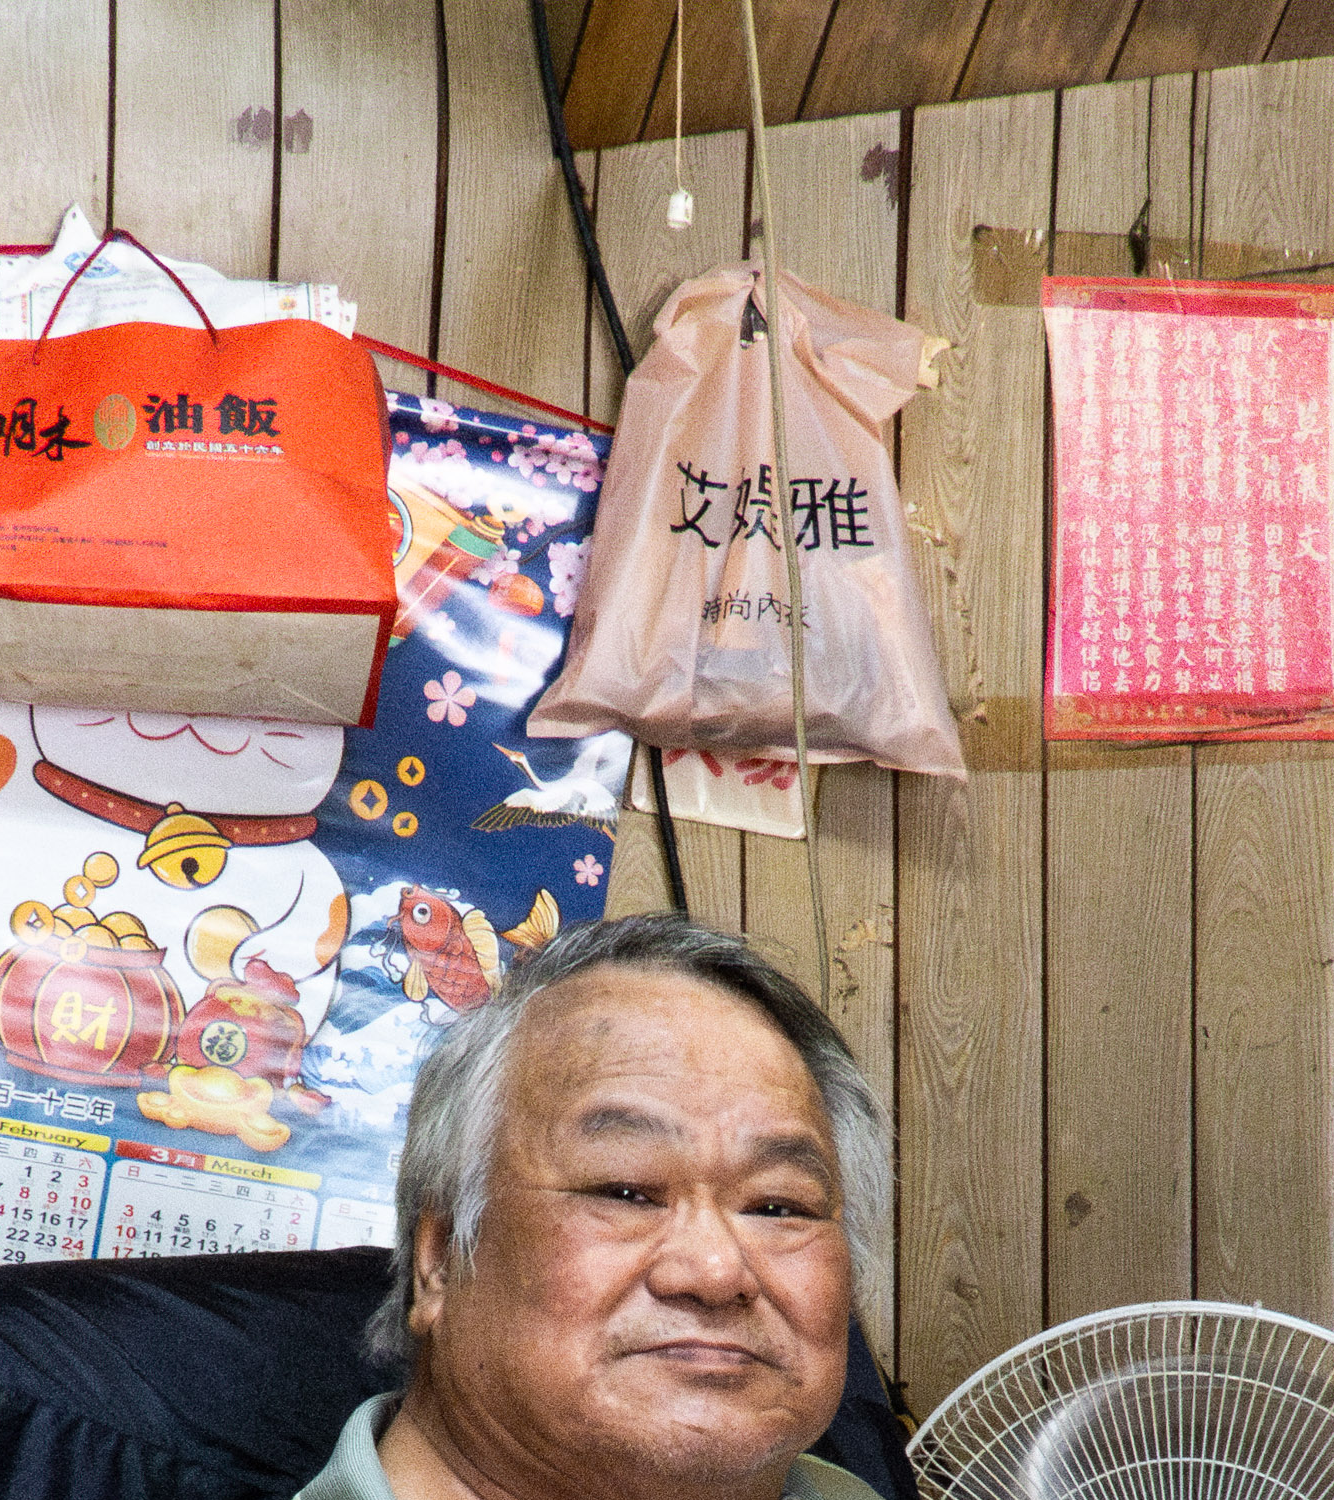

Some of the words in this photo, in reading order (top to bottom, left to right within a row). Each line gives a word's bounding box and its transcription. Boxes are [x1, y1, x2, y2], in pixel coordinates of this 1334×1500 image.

[143, 393, 281, 437] 油飯
[50, 992, 119, 1051] 財
[205, 1026, 239, 1062] 福
[0, 1121, 87, 1148] February
[150, 1148, 195, 1167] 3月
[211, 1159, 273, 1180] March
[25, 1166, 32, 1177] 1
[51, 1171, 62, 1182] 2
[79, 1176, 88, 1188] 3
[19, 1187, 29, 1198] 8
[48, 1191, 58, 1203] 9
[71, 1196, 91, 1209] 10
[12, 1207, 33, 1221] 15
[40, 1212, 60, 1225] 16
[67, 1217, 88, 1230] 17
[6, 1227, 29, 1242] 22
[34, 1233, 57, 1247] 23
[62, 1238, 84, 1250] 24
[3, 1249, 26, 1263] 29
